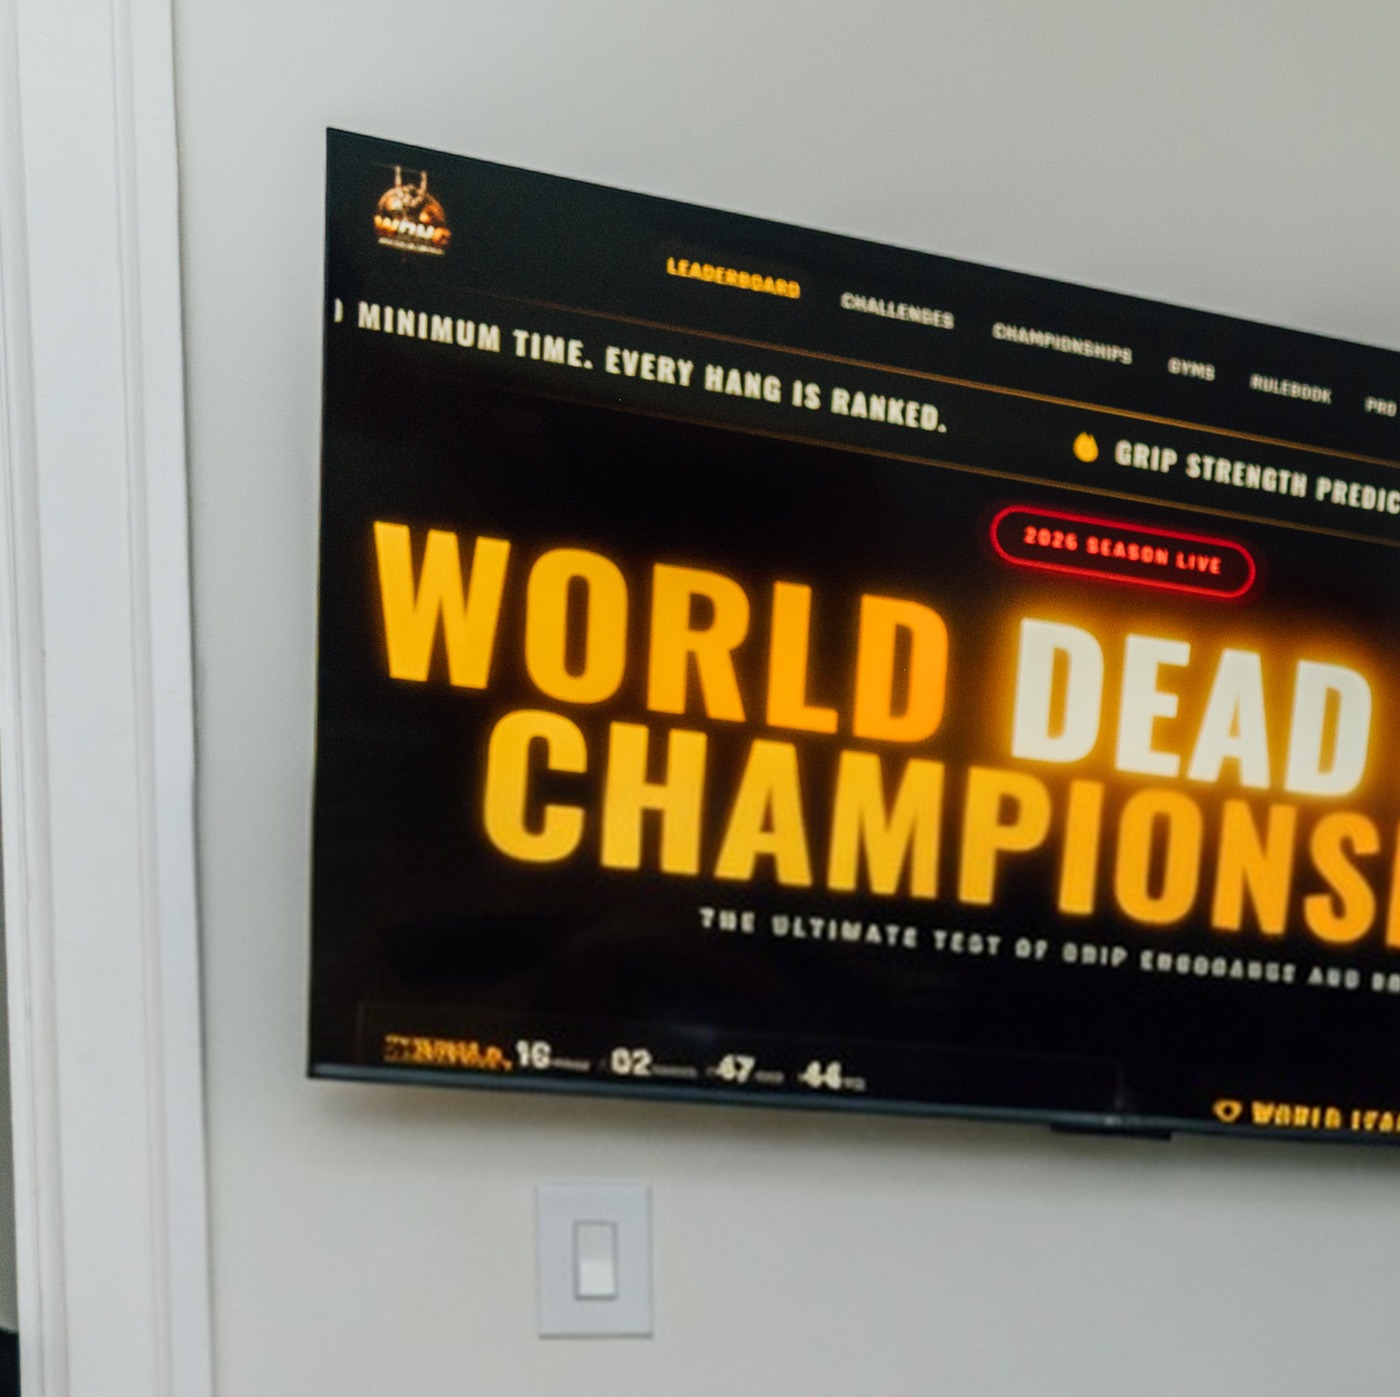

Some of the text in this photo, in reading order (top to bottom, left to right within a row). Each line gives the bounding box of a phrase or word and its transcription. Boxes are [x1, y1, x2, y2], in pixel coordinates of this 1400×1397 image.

[666, 257, 801, 300] LEADERBOARD
[840, 291, 955, 331] CHALLENGES
[992, 321, 1134, 366] CHAMPIONSHIPS
[358, 300, 501, 353] MINIMUM
[512, 329, 594, 371] TIME.
[605, 346, 695, 388] EVERY
[704, 364, 782, 404] HANG
[792, 380, 821, 411] IS
[831, 387, 948, 433] RANKED.
[1167, 355, 1216, 382] GYMS
[1250, 372, 1332, 405] RULEBOOK
[1365, 394, 1398, 418] PRO
[1114, 440, 1180, 475] GRIP
[1186, 452, 1309, 499] STRENGTH
[1023, 525, 1222, 576] 2026 SEASON LIVE
[373, 520, 949, 743] WORLD
[1010, 616, 1374, 798] DEAD
[700, 906, 755, 933] THE
[771, 914, 918, 949] ULTIMATE
[611, 1047, 652, 1076] 02
